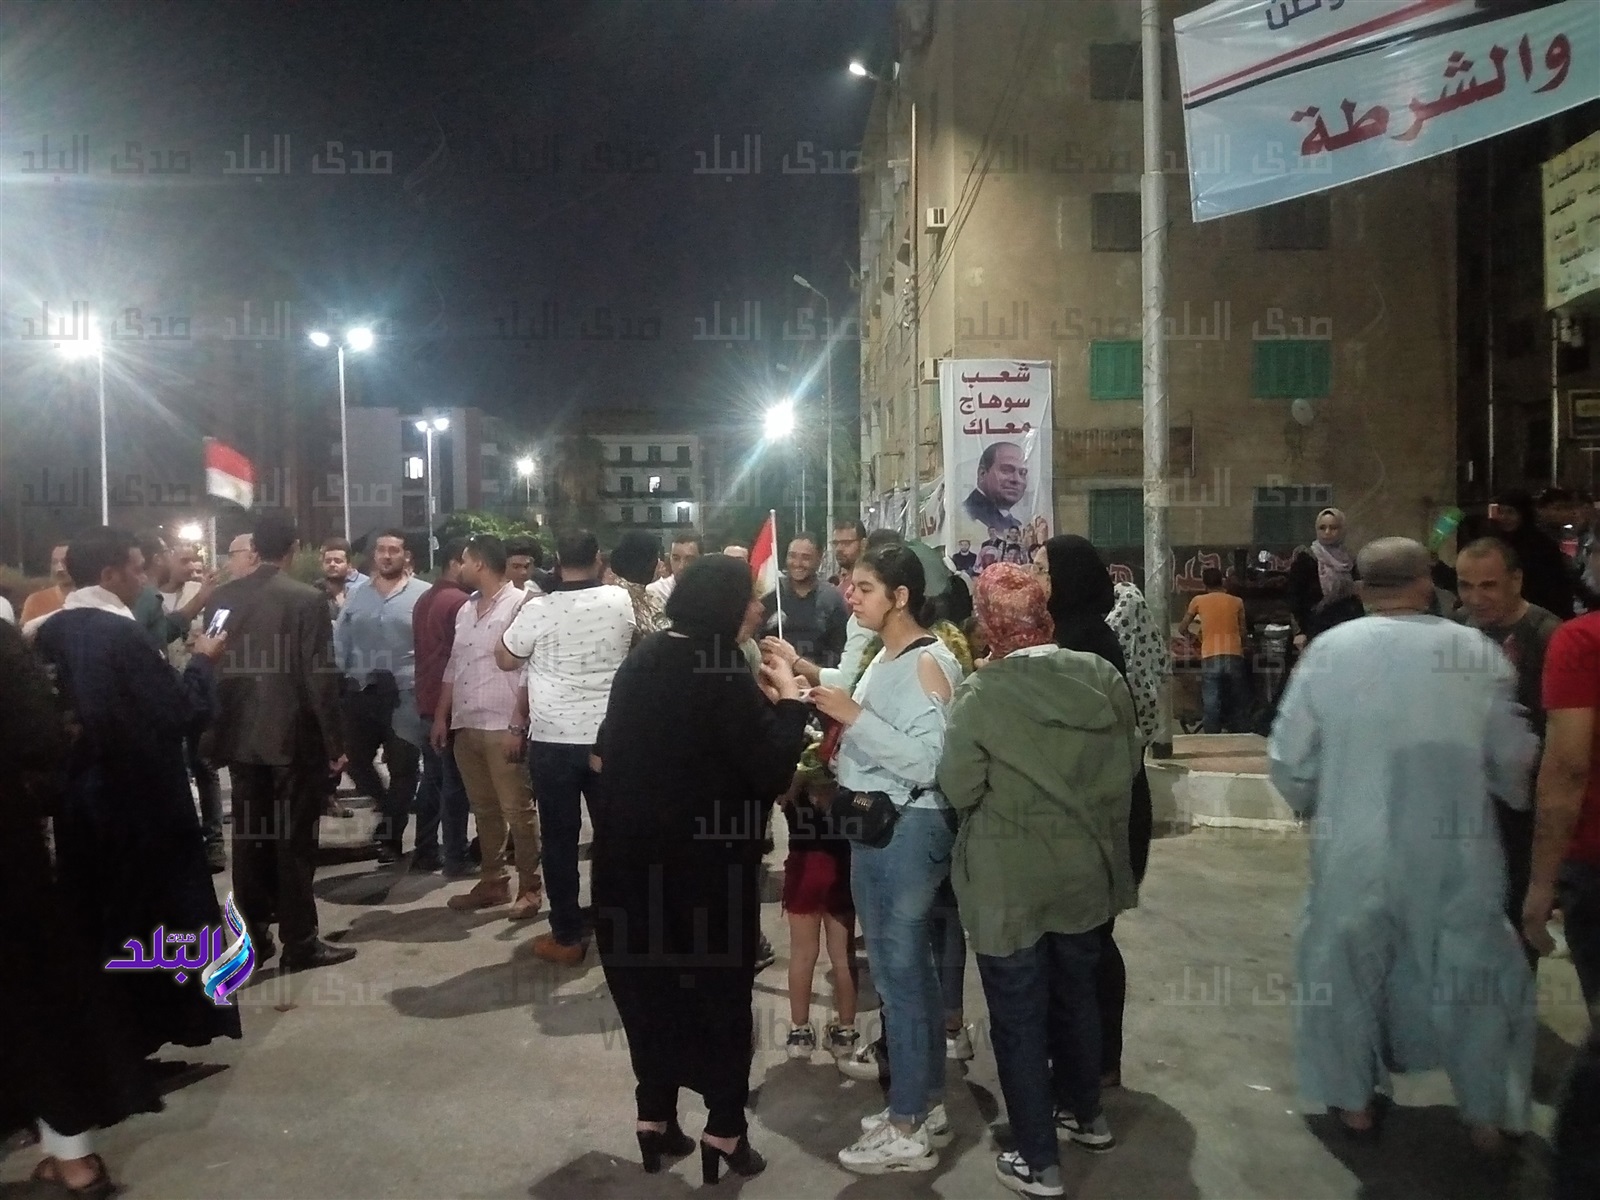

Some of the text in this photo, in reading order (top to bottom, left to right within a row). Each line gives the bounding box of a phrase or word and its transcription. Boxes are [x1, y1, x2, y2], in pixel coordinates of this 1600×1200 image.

[1290, 32, 1571, 156] والشرطة
[961, 363, 1031, 388] شعب
[959, 392, 1031, 414] سوهاج
[963, 418, 1032, 435] معاك
